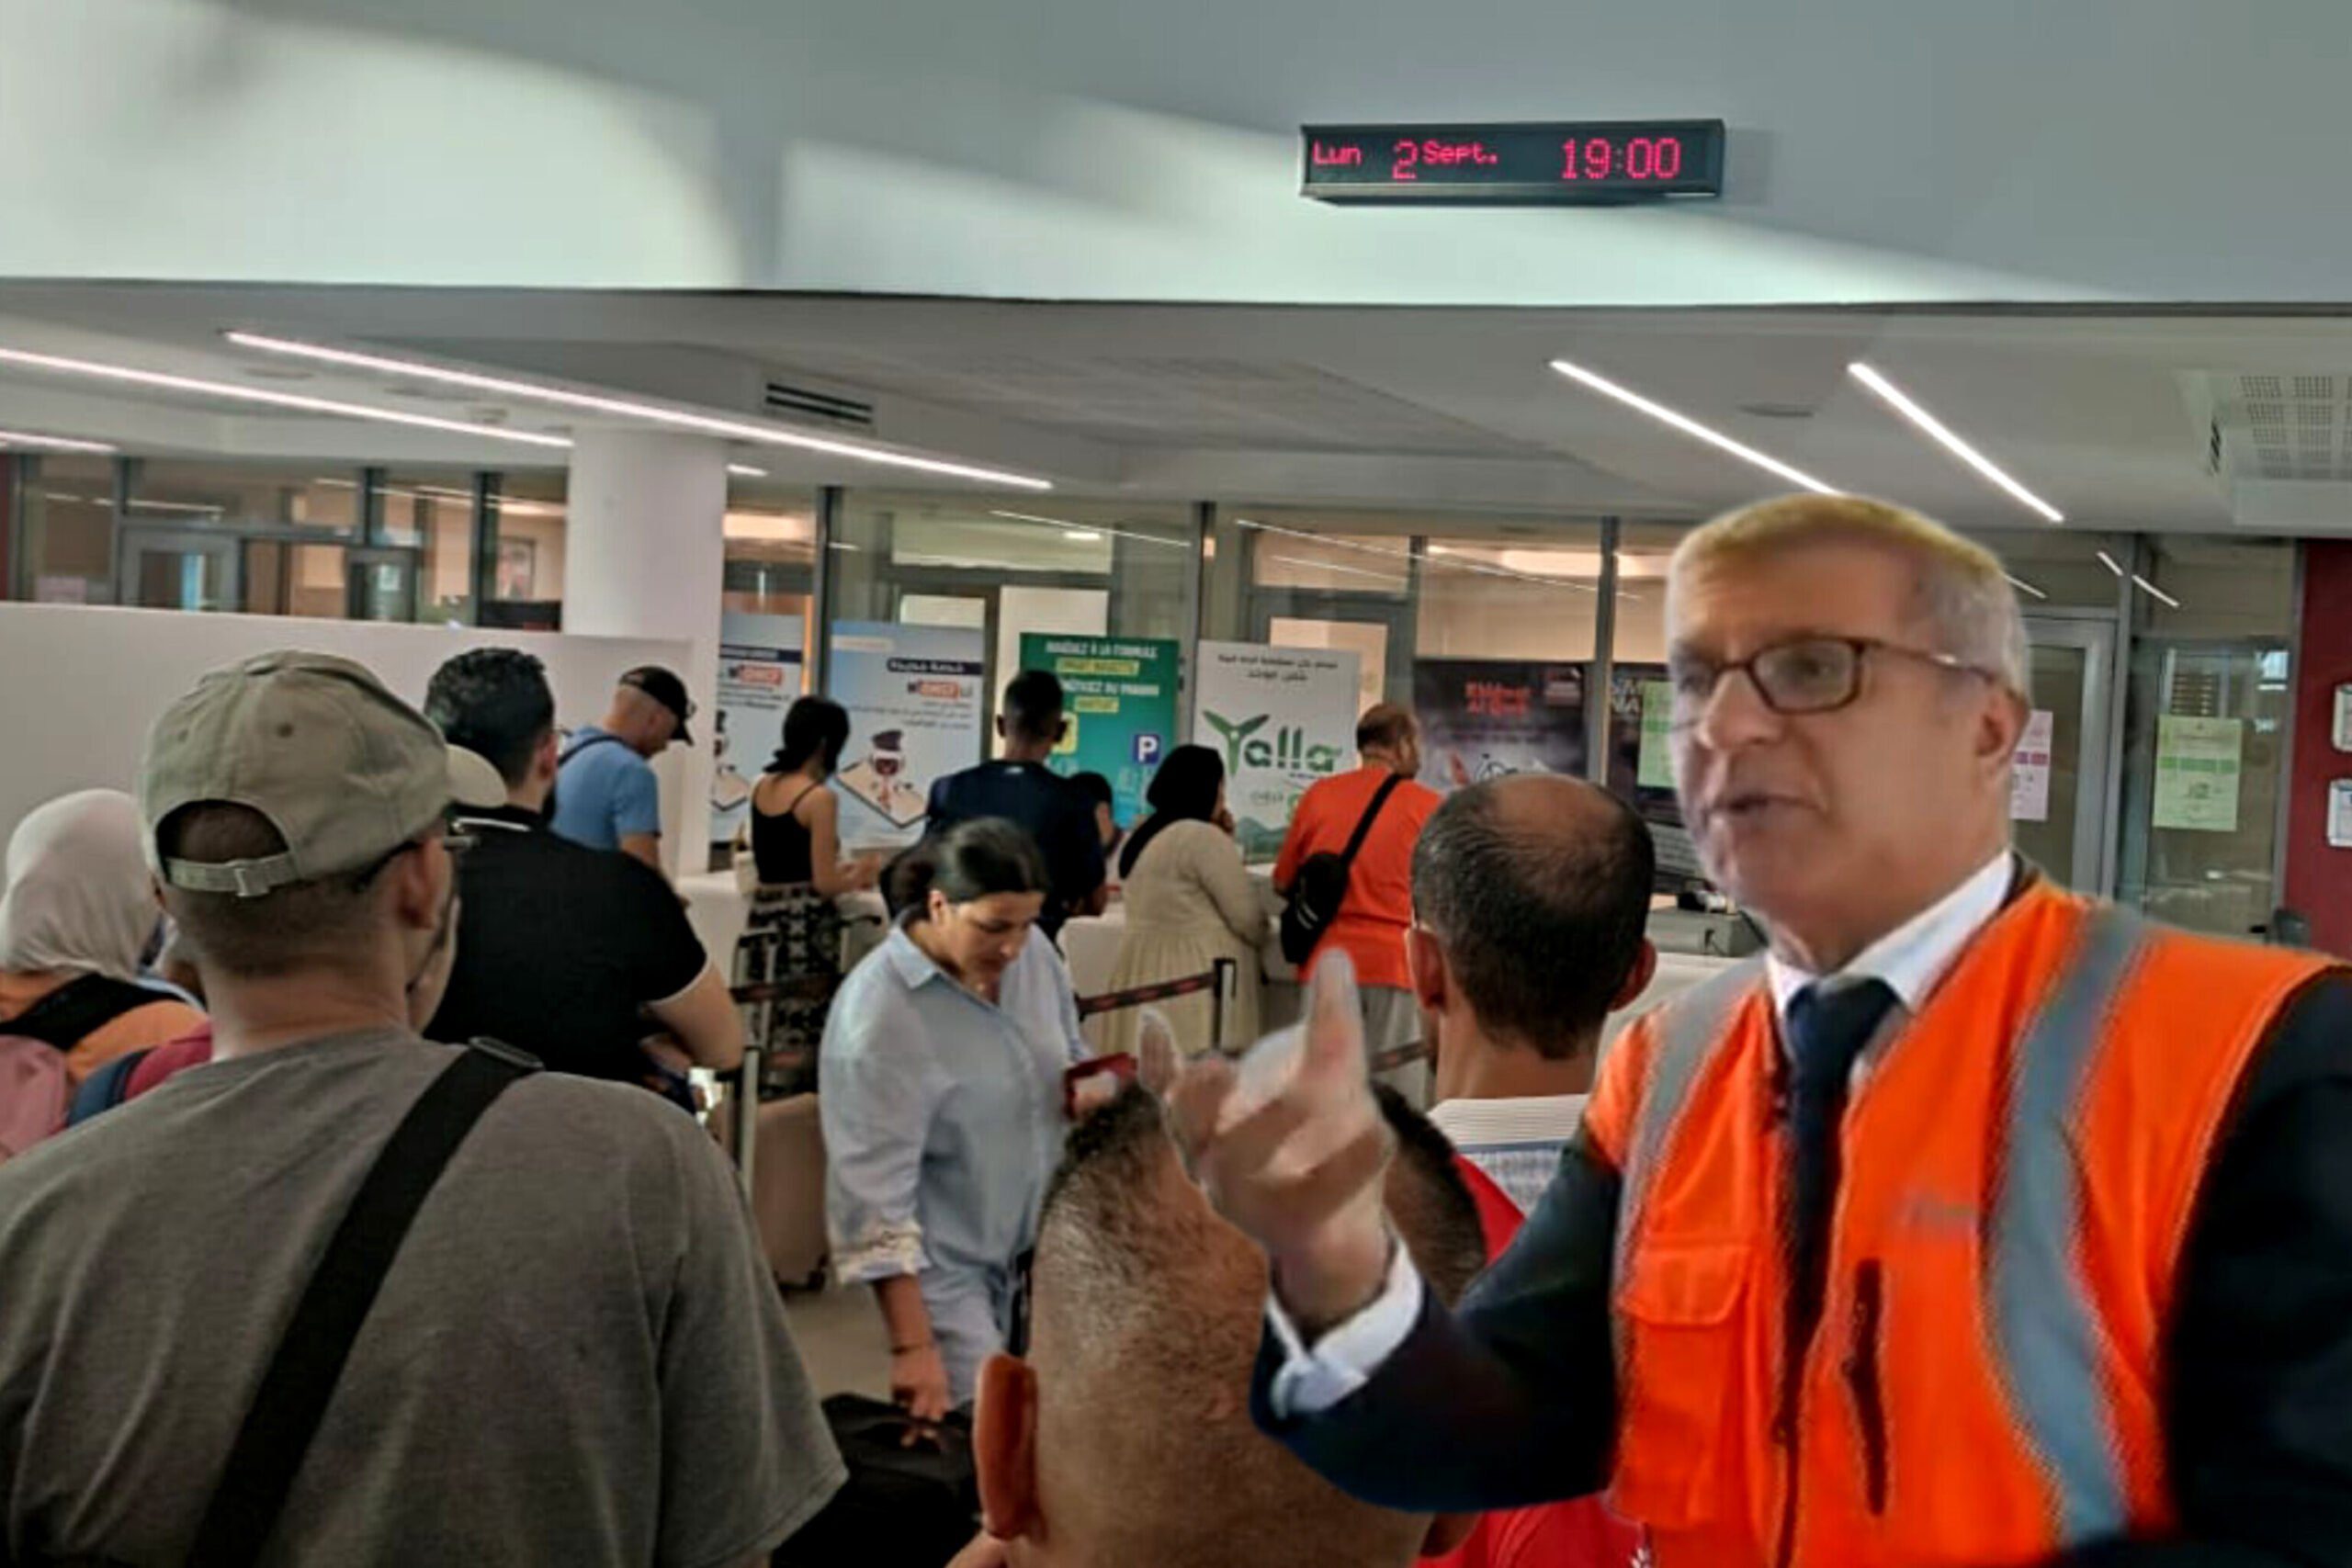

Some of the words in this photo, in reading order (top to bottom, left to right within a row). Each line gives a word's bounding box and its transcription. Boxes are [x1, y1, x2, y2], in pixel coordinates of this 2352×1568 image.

[1313, 141, 1362, 164] Lun
[1392, 140, 1419, 180] 2
[1422, 141, 1498, 165] Sept.
[1562, 138, 1681, 180] 19:00
[1138, 736, 1158, 762] P
[1203, 709, 1342, 778] Yalla
